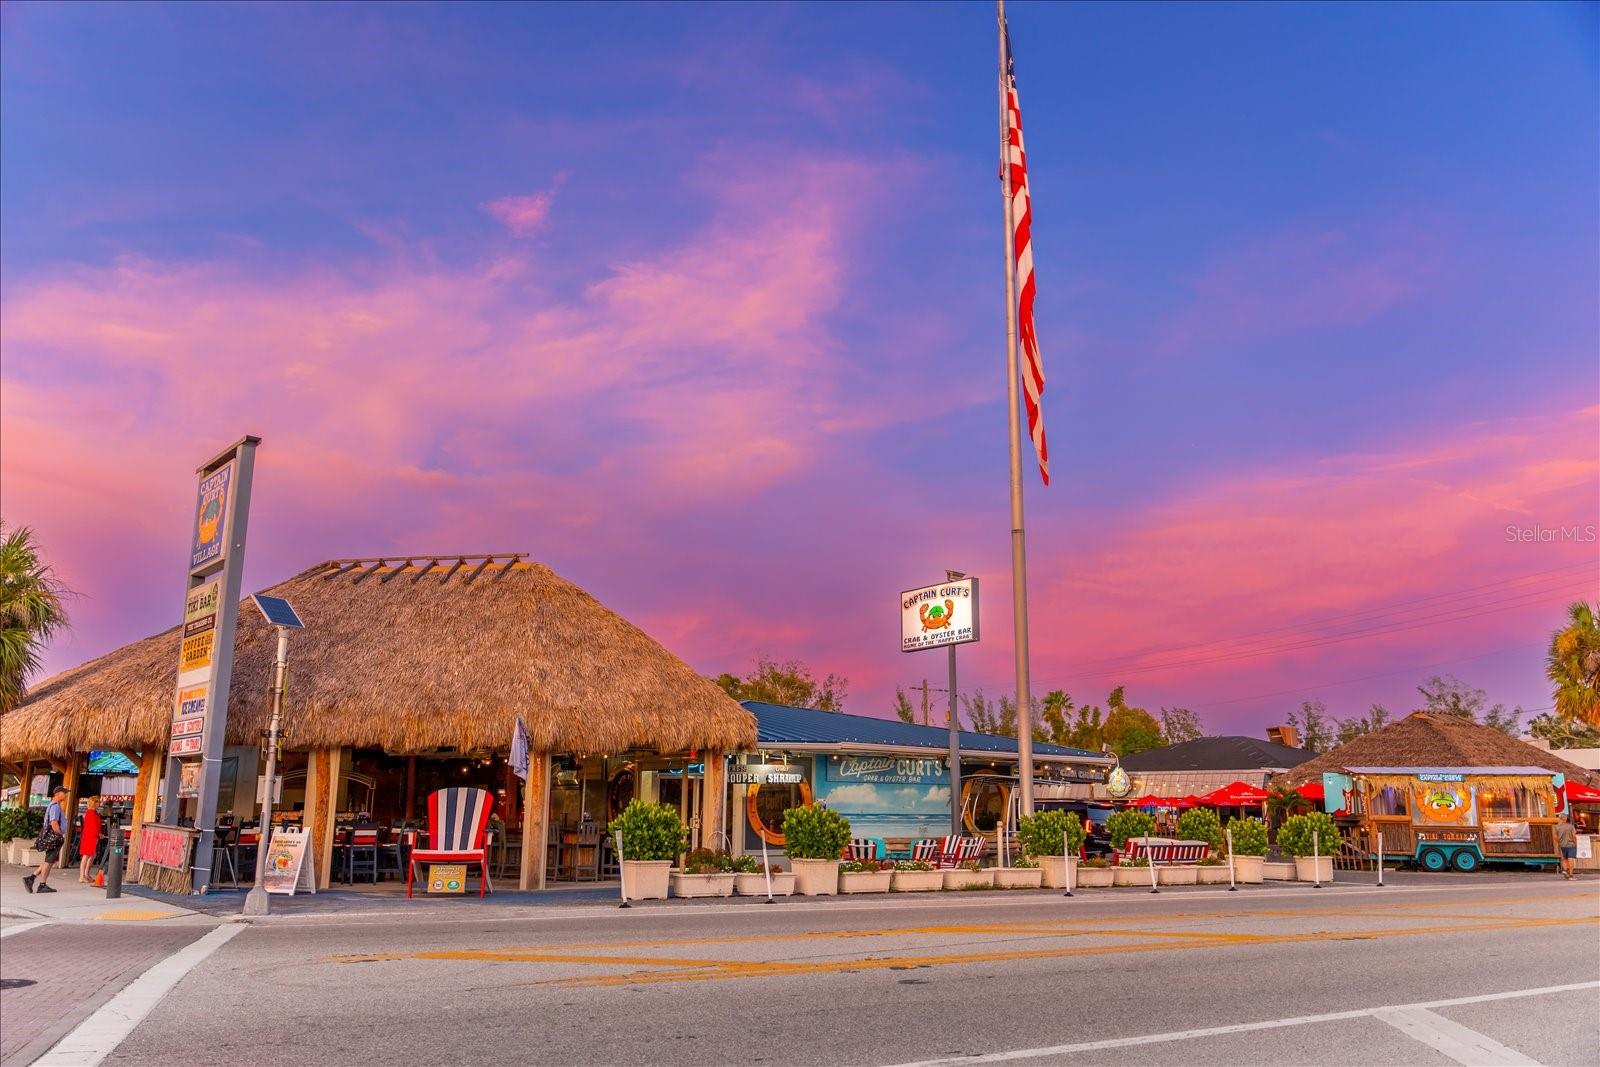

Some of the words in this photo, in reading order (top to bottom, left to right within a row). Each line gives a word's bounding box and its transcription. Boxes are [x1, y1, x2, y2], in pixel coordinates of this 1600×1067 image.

[201, 468, 230, 496] CAPTAIN
[193, 543, 220, 565] VILLAGE
[188, 600, 199, 614] TIKI
[199, 594, 211, 609] BAR
[903, 590, 937, 609] CAPTAIN
[940, 587, 969, 598] CURT'S
[183, 635, 205, 652] COFFEE
[904, 636, 921, 644] CRAB
[931, 630, 955, 640] OYSTER
[958, 627, 972, 635] BAR
[185, 646, 207, 662] GARDEN
[840, 757, 896, 778] Captain
[897, 759, 943, 777] CURT'S
[727, 773, 759, 783] OUPER
[767, 773, 802, 783] SHRIMP
